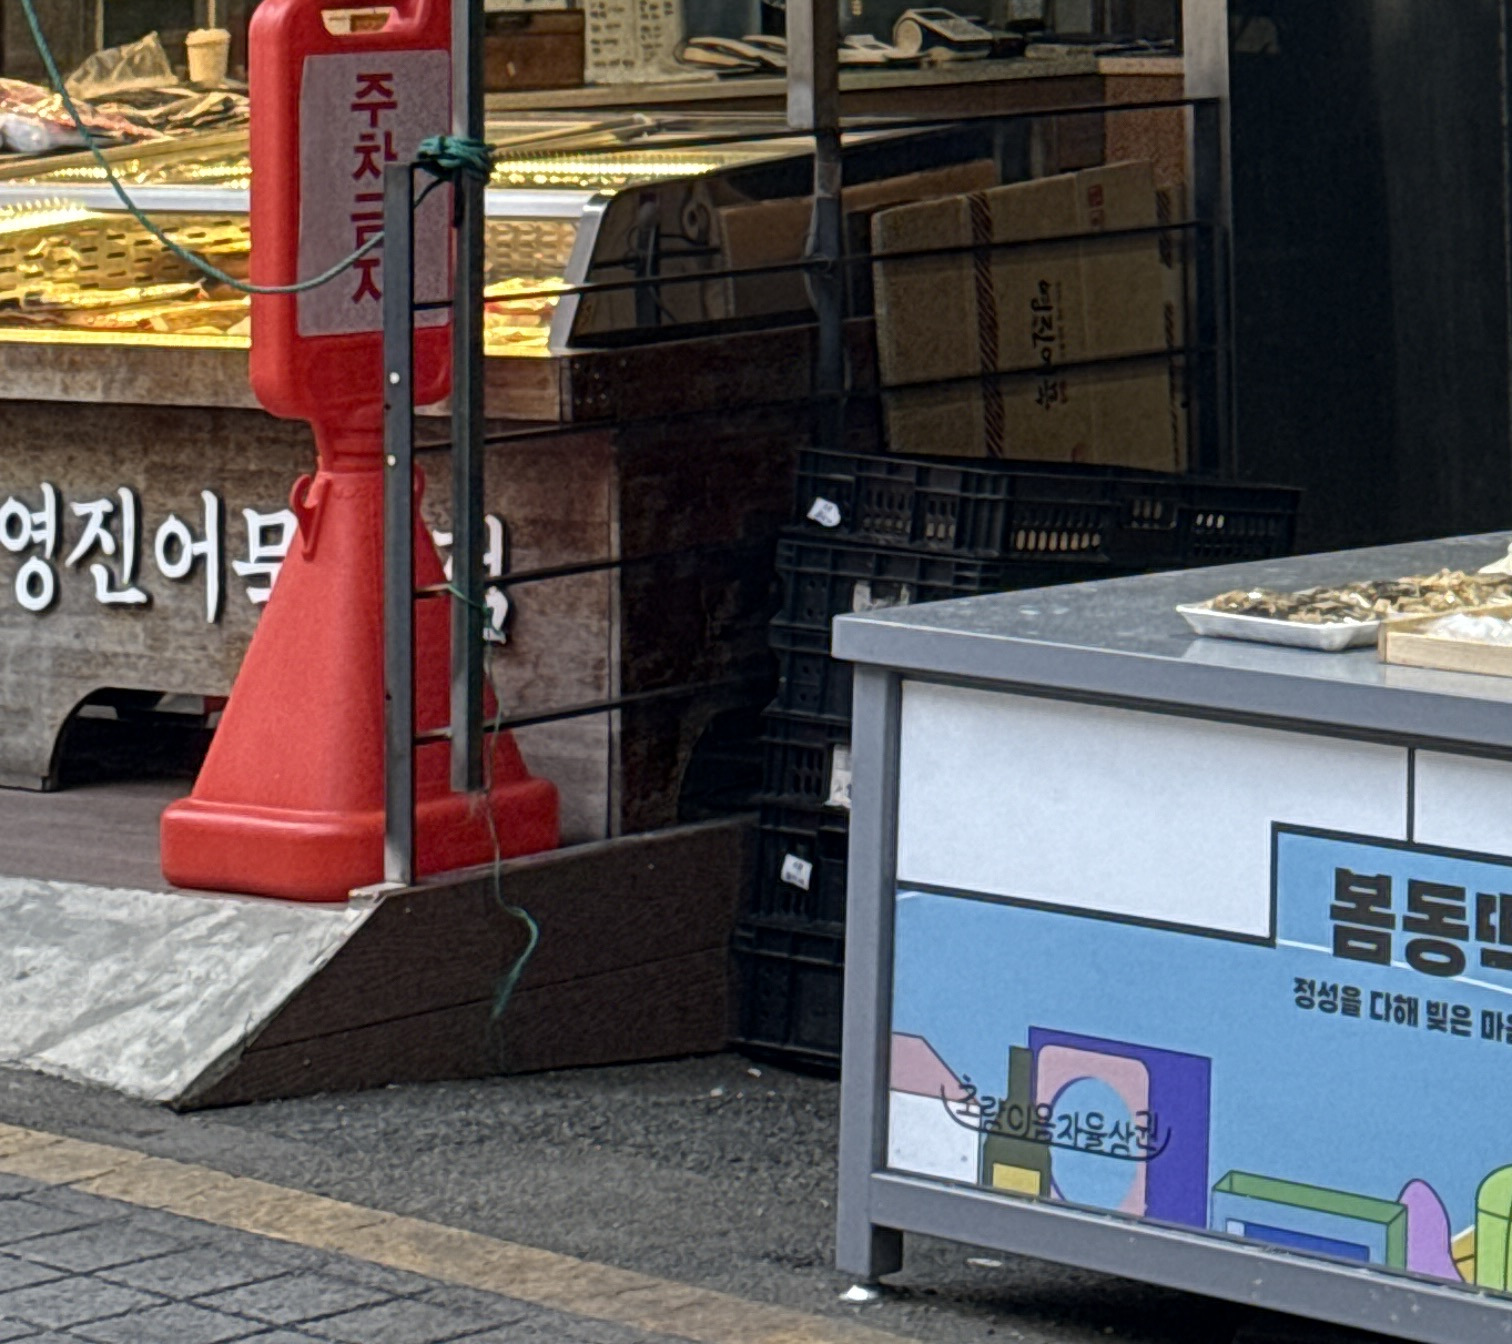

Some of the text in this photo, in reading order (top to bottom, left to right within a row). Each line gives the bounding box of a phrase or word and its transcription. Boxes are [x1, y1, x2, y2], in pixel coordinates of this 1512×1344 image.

[1293, 976, 1362, 1019] 정성을
[1369, 989, 1419, 1028] 다해
[1426, 1000, 1472, 1038] 빚은
